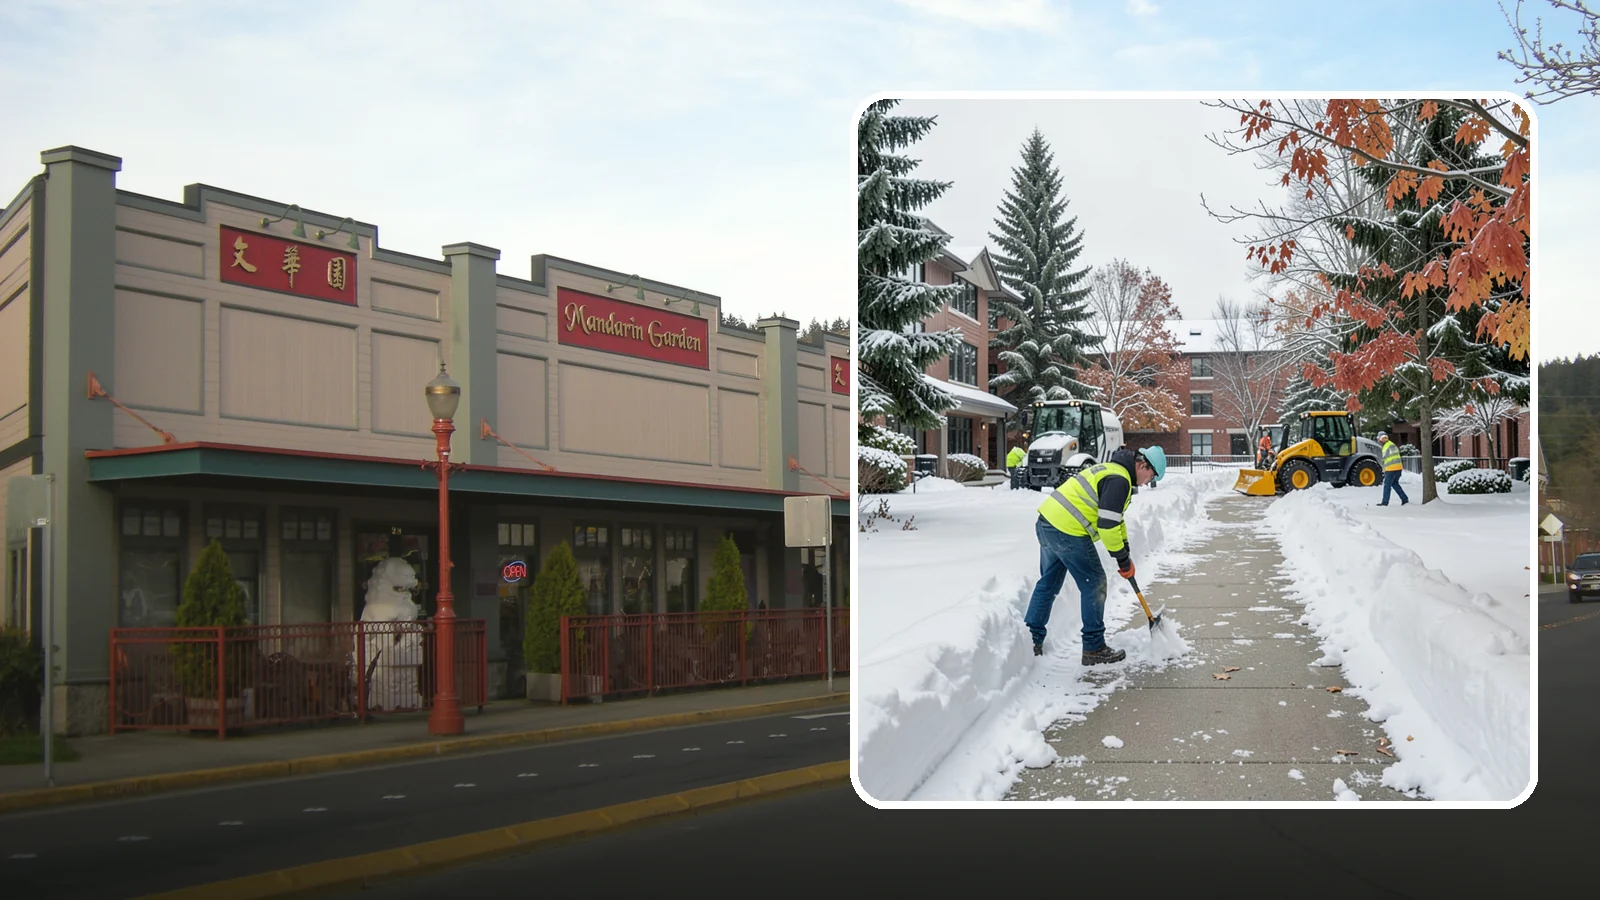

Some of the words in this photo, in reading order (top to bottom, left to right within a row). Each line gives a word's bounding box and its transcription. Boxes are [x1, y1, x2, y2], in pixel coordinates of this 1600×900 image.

[231, 236, 346, 291] 文華園
[564, 302, 644, 341] Mandarin
[647, 320, 701, 352] Garden
[391, 526, 402, 535] 28
[503, 565, 527, 578] OPEN
